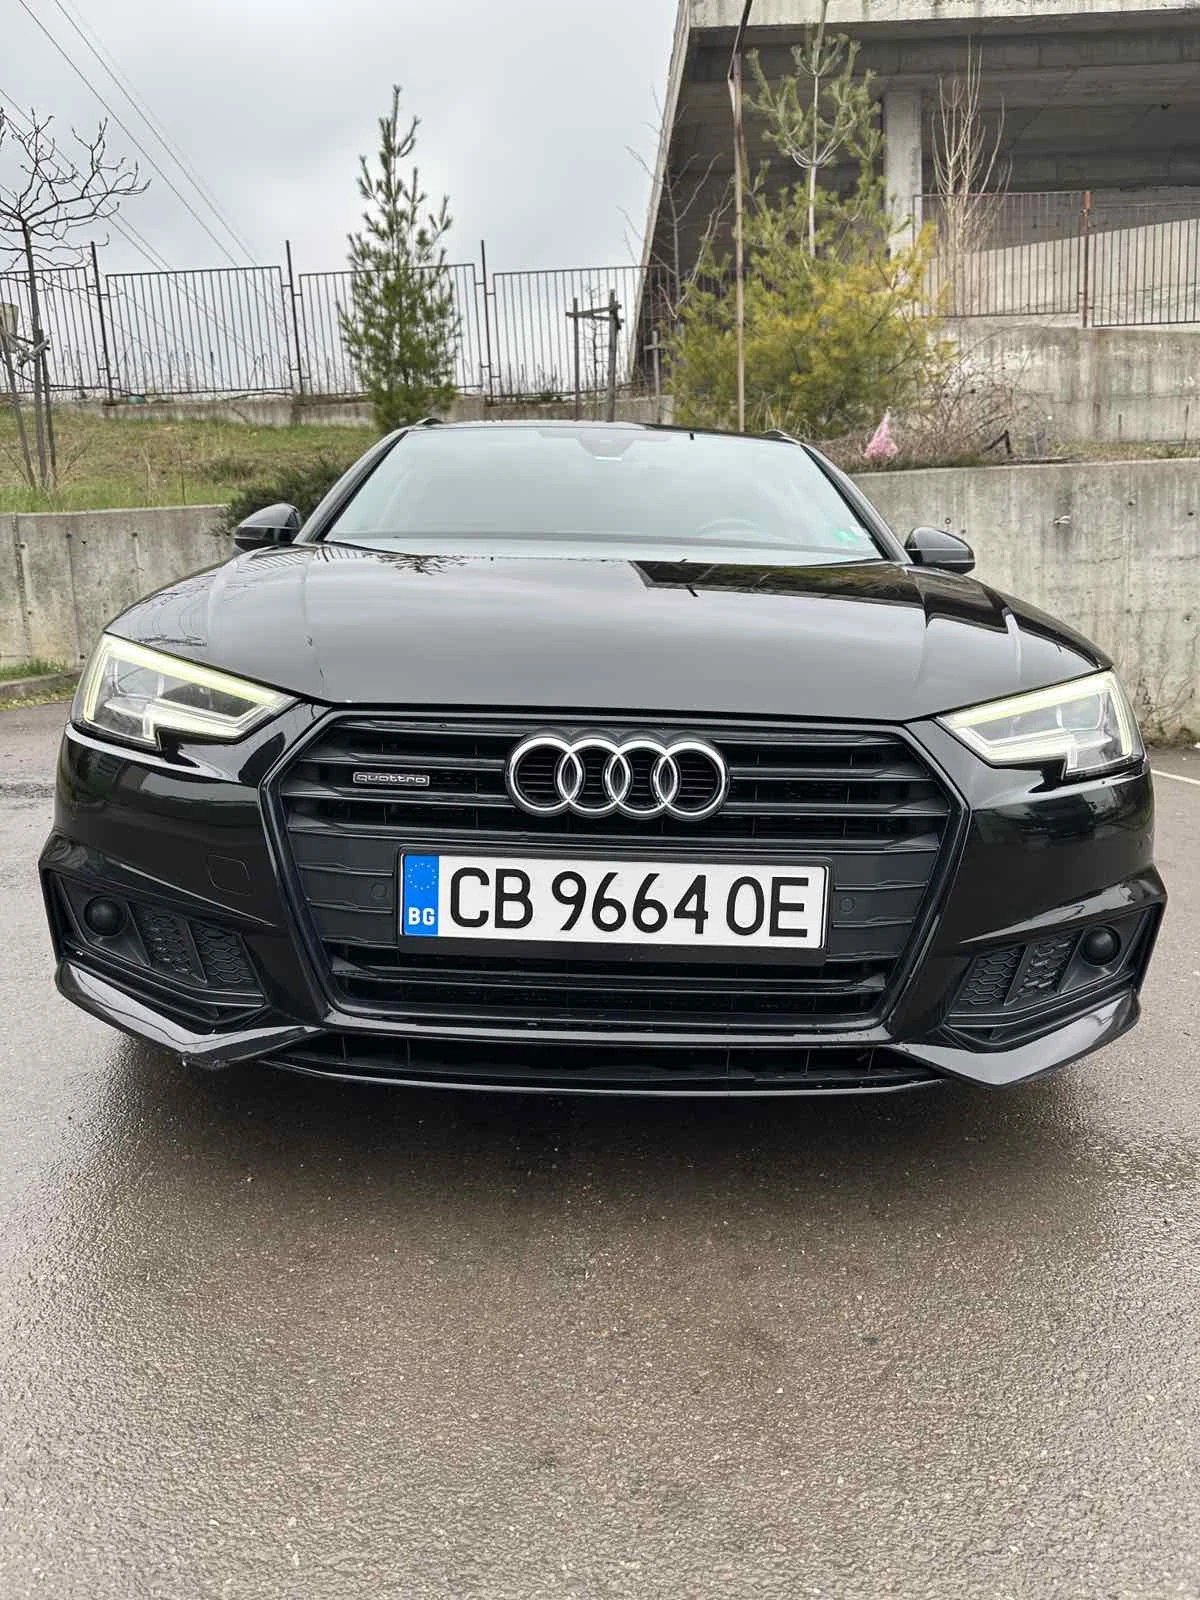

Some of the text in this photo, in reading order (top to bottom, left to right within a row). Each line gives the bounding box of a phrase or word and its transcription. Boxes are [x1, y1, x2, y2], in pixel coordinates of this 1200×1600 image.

[355, 774, 427, 784] quattro
[450, 867, 534, 929] CB
[551, 870, 709, 935] 9664
[408, 906, 435, 926] BG
